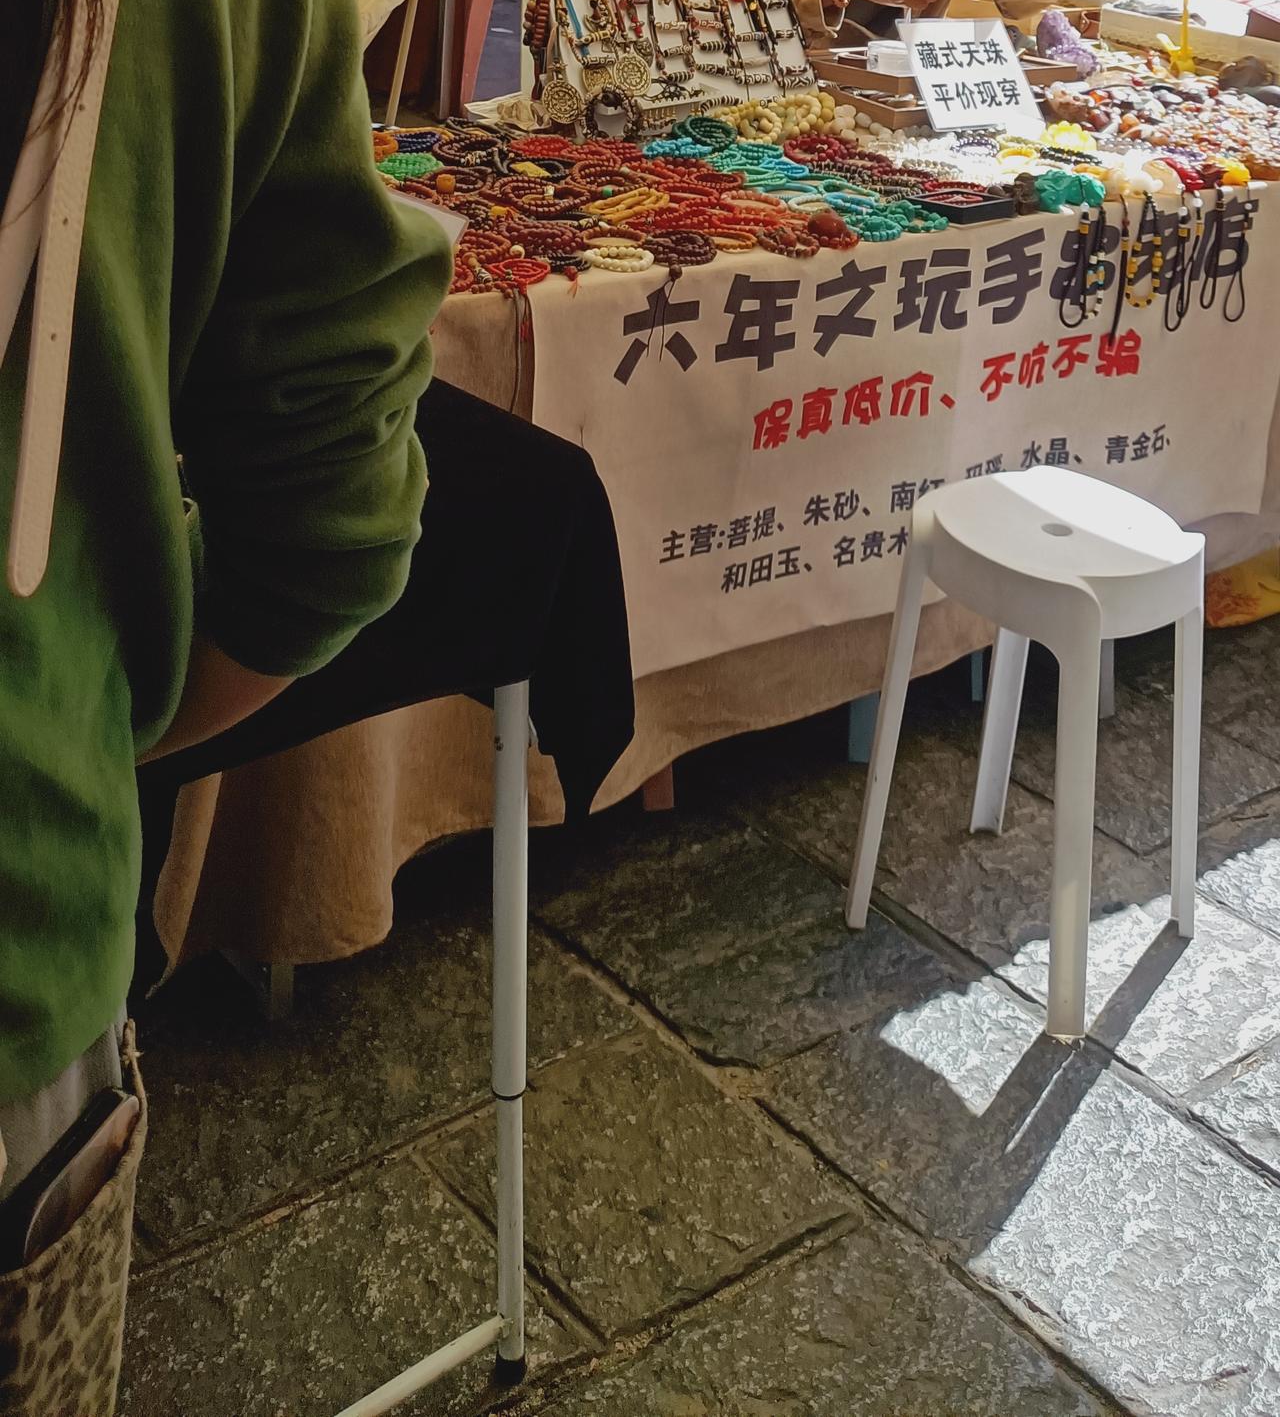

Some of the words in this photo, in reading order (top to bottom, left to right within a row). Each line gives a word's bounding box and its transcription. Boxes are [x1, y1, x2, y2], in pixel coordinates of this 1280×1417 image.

[914, 38, 1008, 70] 藏式天珠
[931, 78, 1021, 112] 平价现穿
